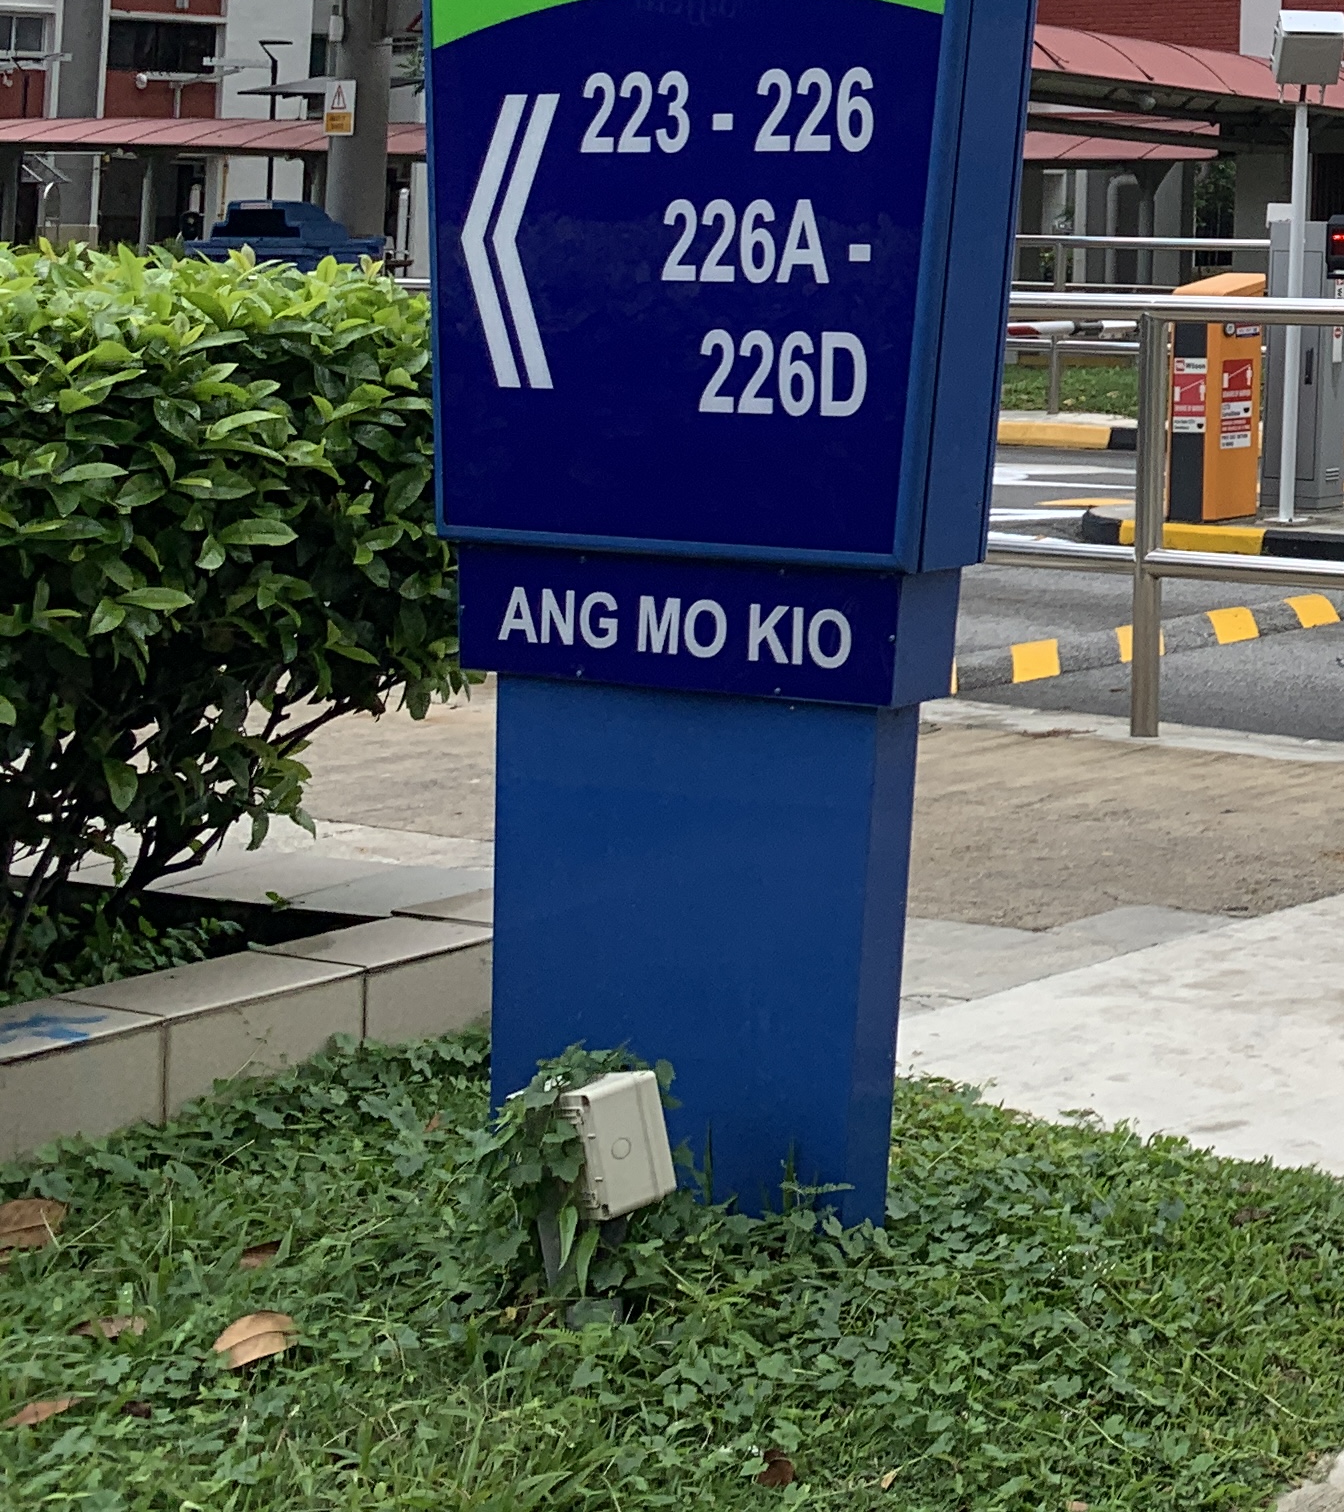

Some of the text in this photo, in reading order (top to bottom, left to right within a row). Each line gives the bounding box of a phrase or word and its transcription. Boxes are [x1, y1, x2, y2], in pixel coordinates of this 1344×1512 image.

[580, 66, 874, 153] 223 - 226
[661, 199, 871, 283] 226A -
[699, 329, 867, 416] 226D
[498, 586, 852, 669] ANG MO KIO
